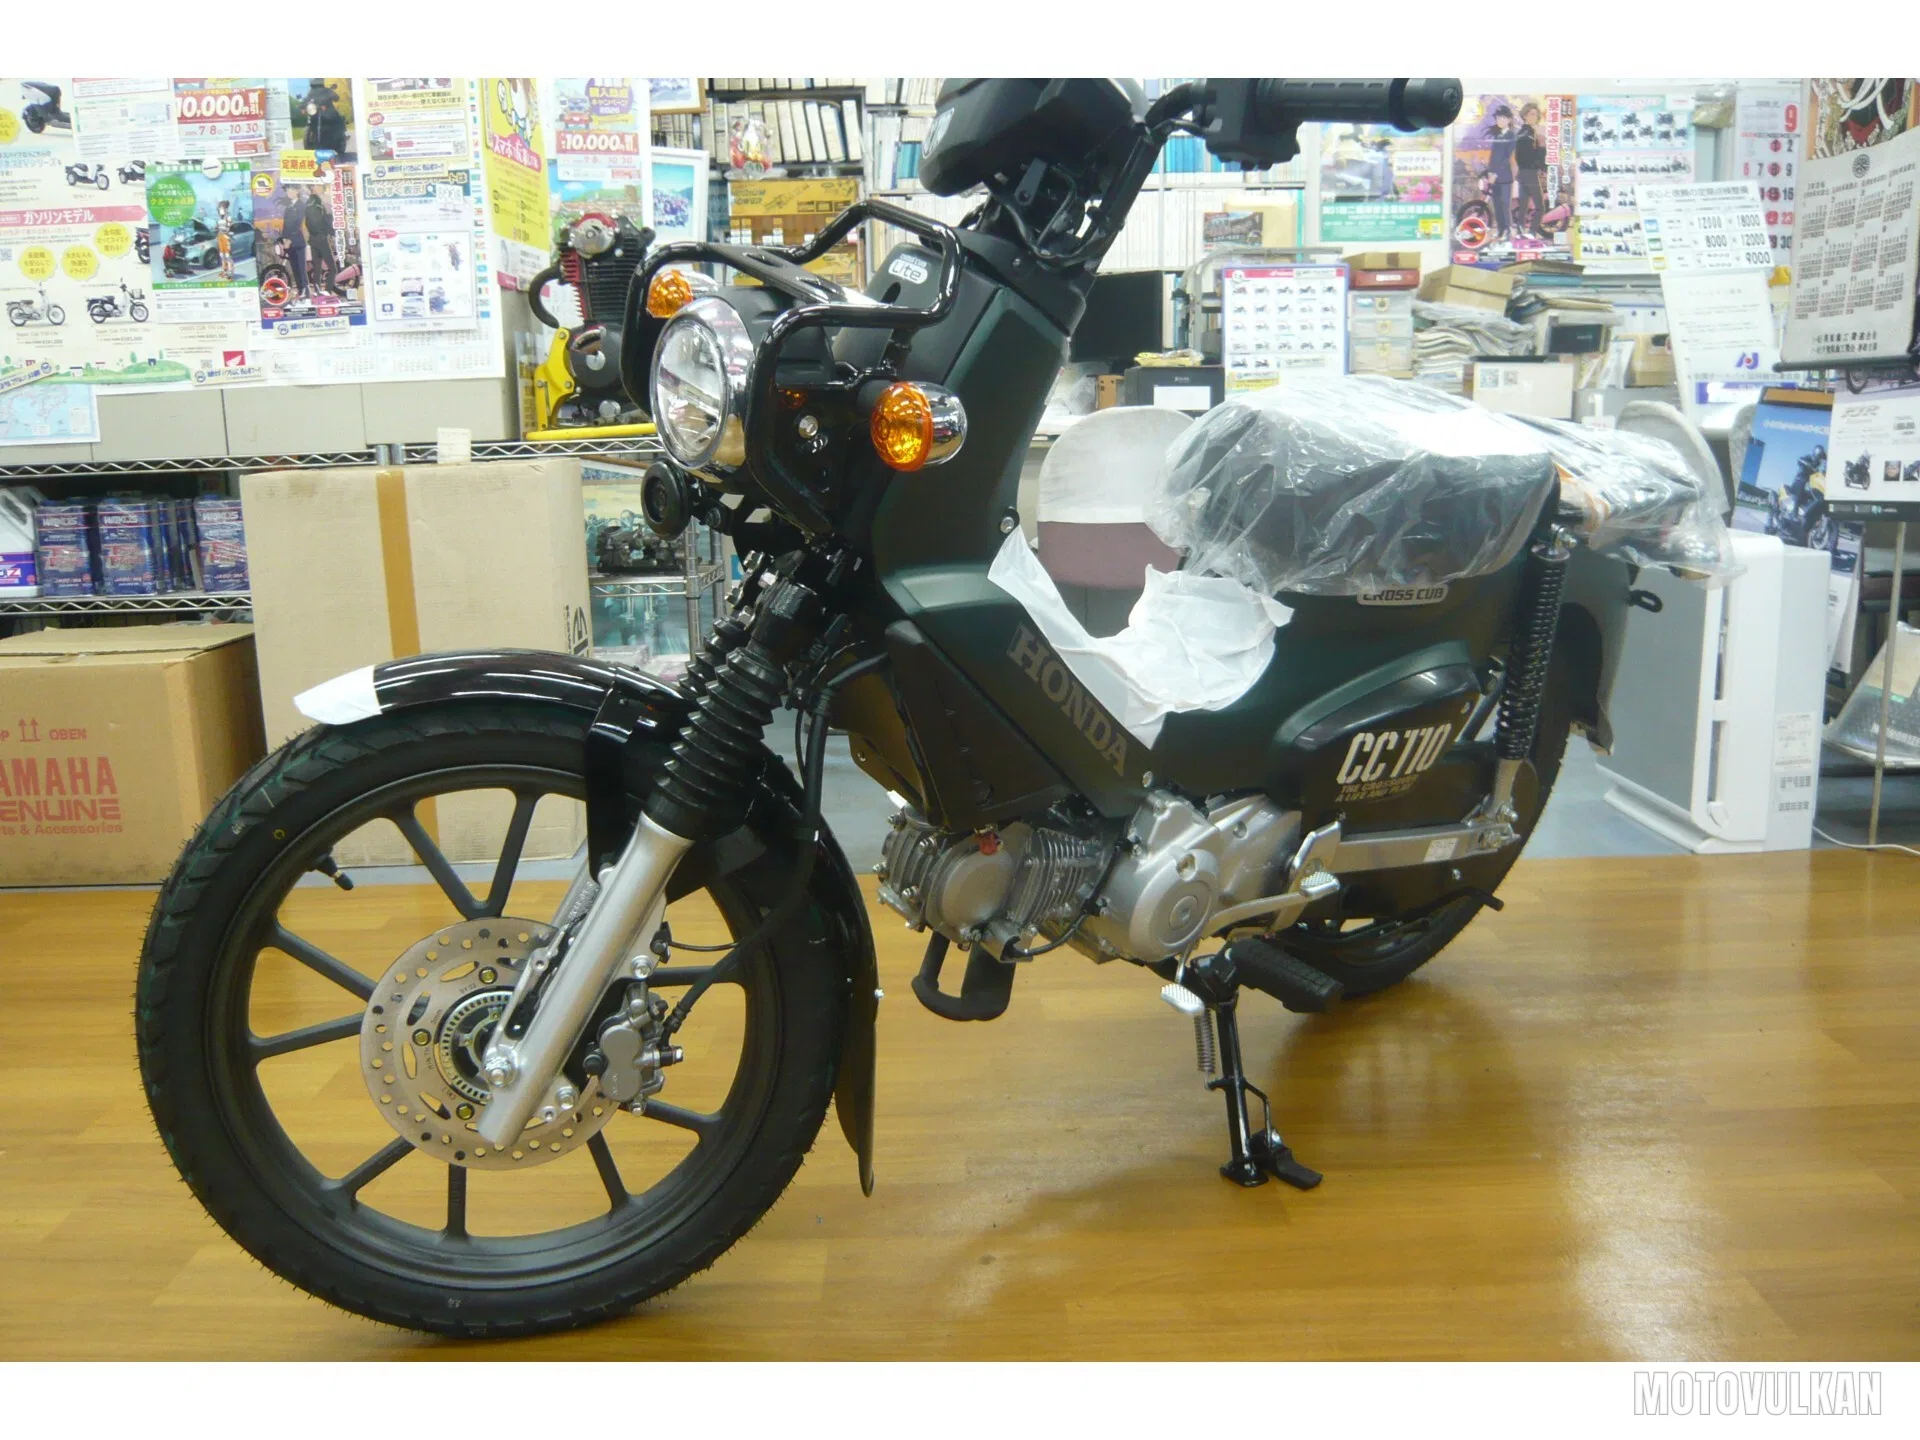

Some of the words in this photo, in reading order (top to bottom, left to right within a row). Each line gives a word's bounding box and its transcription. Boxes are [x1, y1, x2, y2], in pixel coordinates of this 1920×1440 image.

[1784, 104, 1798, 132] 9
[1787, 139, 1793, 152] 2
[282, 159, 316, 169] 定期点検
[1757, 162, 1764, 176] 7
[1786, 162, 1792, 177] 9
[1783, 187, 1794, 201] 16
[24, 208, 94, 225] ガソリンモデル
[891, 260, 923, 282] Lite
[1416, 587, 1444, 600] CUB
[1006, 620, 1127, 777] HONDA
[49, 728, 88, 741] OBEN
[20, 824, 30, 835] &
[34, 822, 124, 835] Accessories
